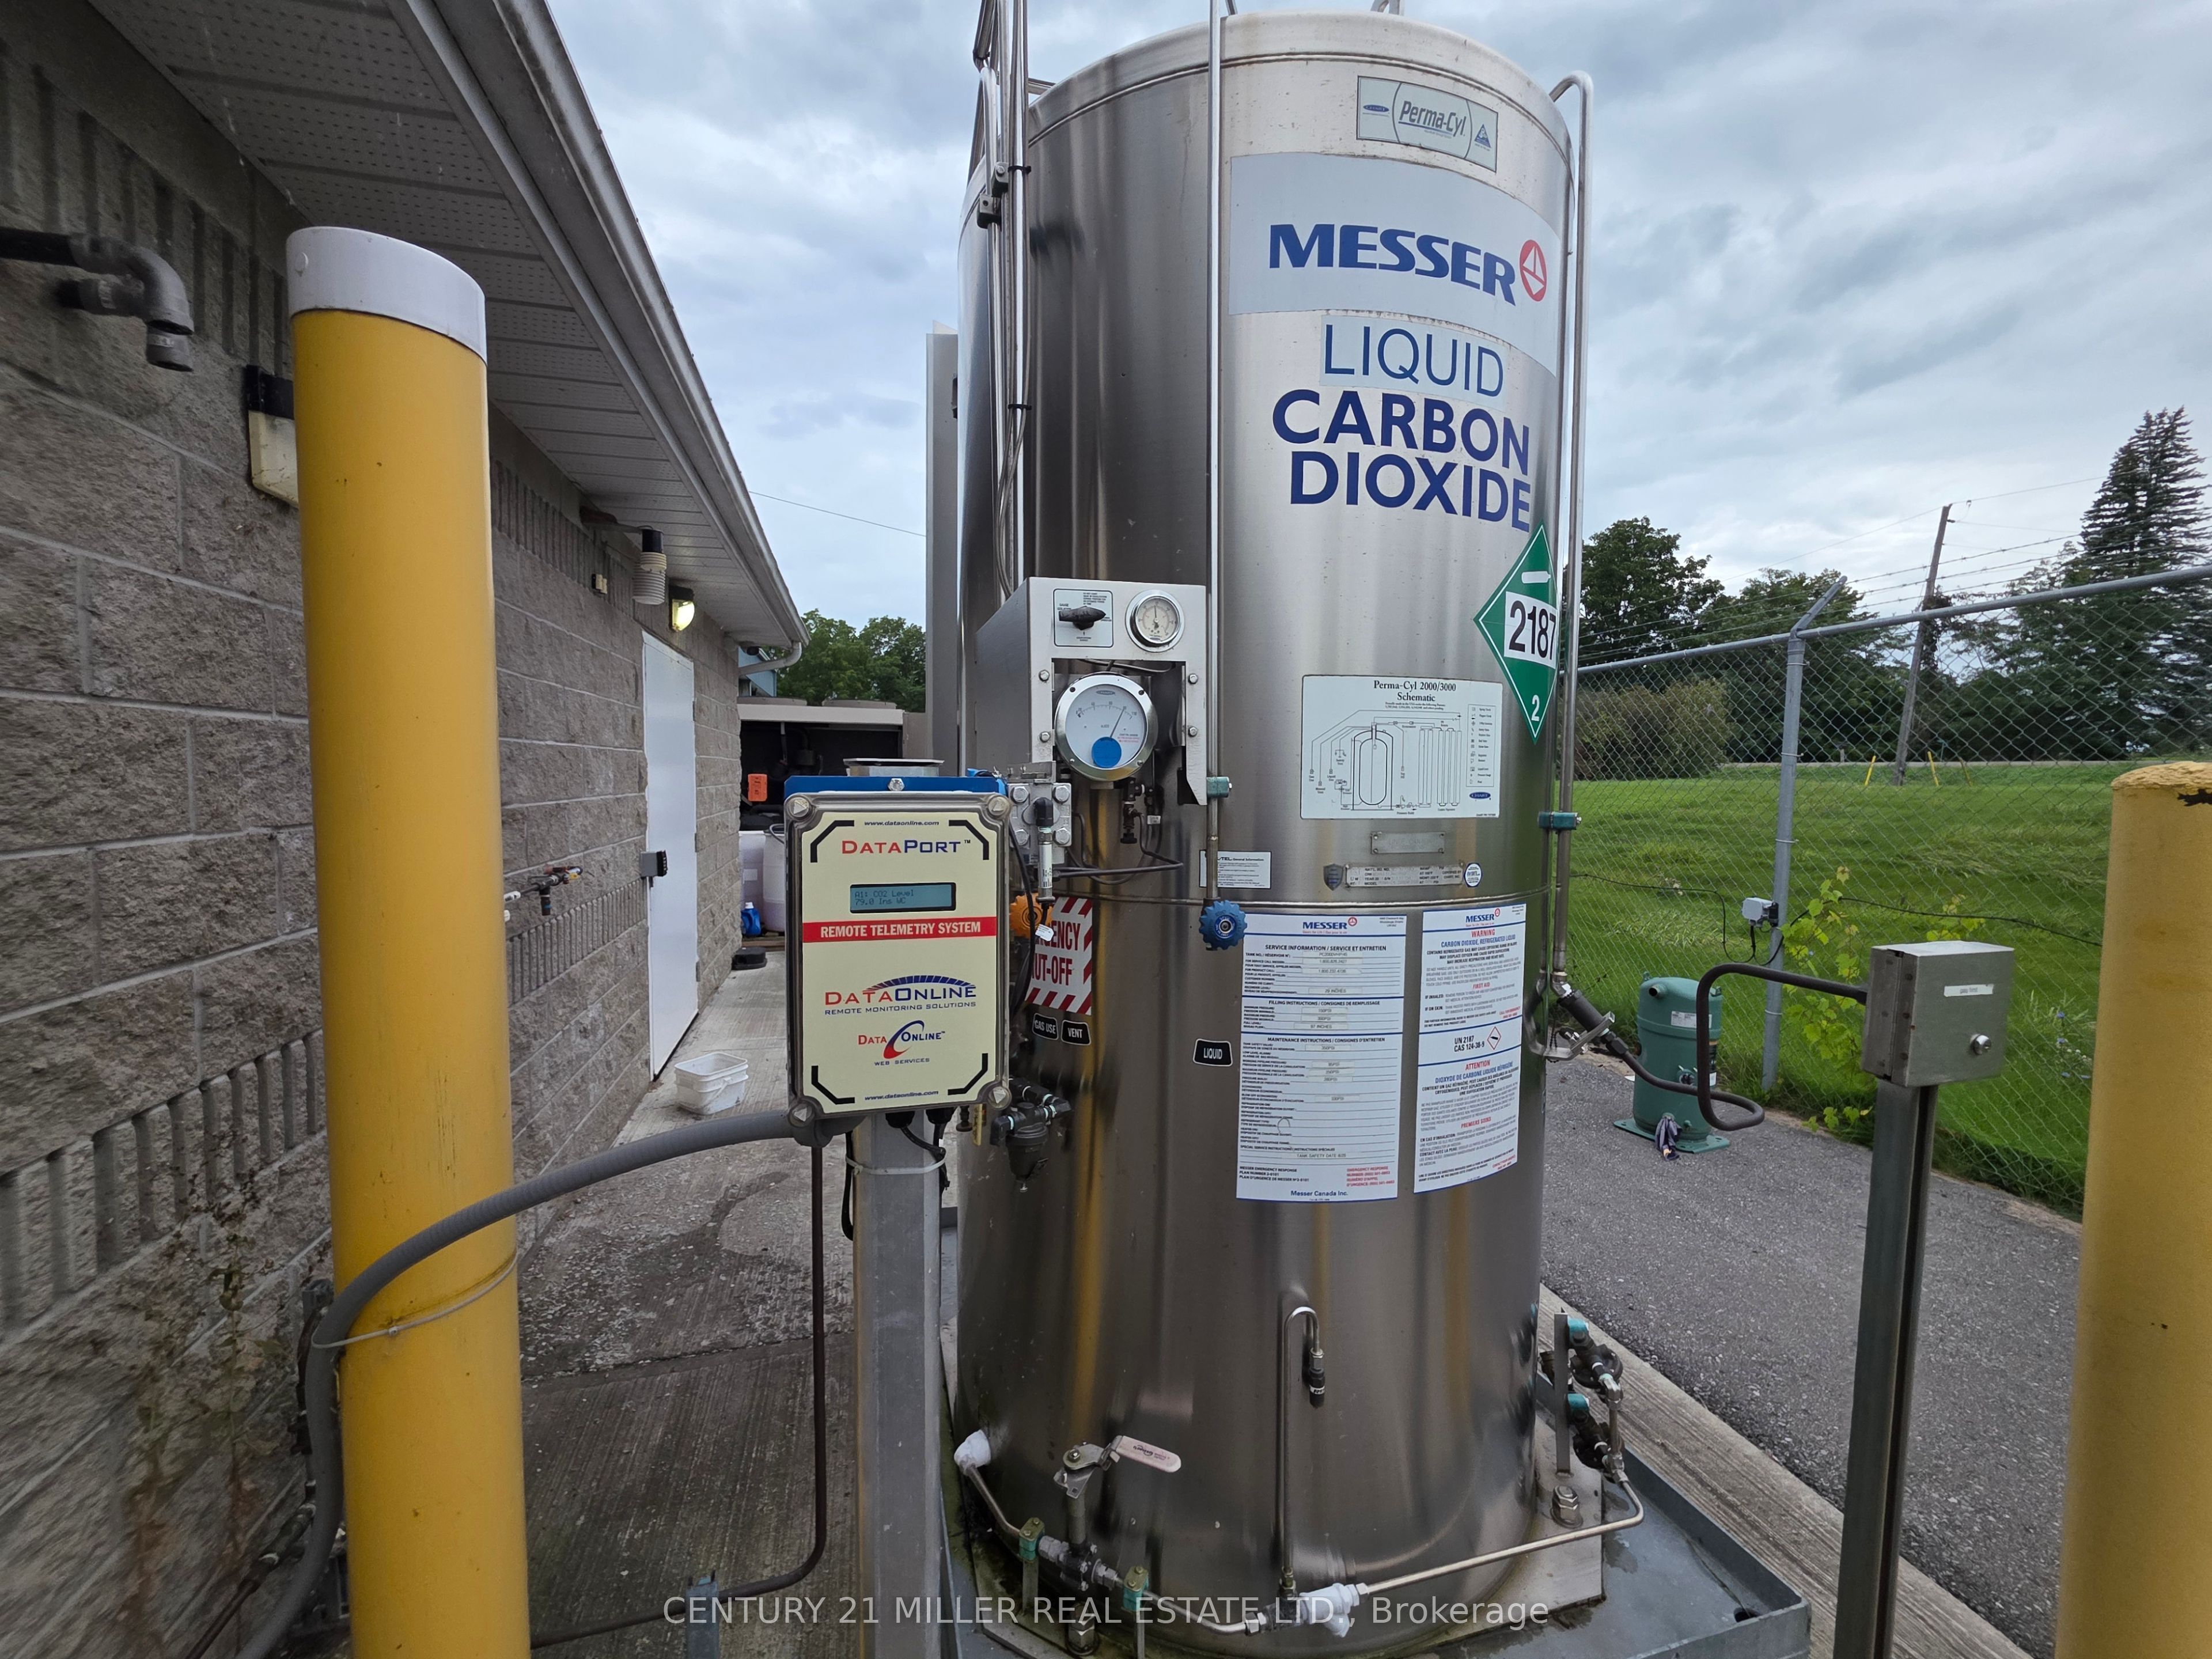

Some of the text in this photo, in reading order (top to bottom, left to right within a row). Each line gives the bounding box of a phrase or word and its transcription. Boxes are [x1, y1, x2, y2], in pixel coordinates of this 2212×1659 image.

[1269, 224, 1516, 306] MESSER
[1324, 324, 1504, 397] LIQUID
[1272, 389, 1529, 476] CARBON
[1290, 450, 1531, 532] DIOXIDE
[1508, 600, 1556, 661] 2187
[1373, 680, 1456, 692] Perma-Cyl 2000/3000
[1397, 692, 1436, 702] Schematic
[1531, 694, 1540, 721] 2
[1465, 914, 1495, 923] MESSER
[820, 921, 981, 938] REMOTE TELEMETRY SYSTEM
[1302, 921, 1347, 930] MESSER
[1471, 929, 1495, 938] WARNING
[824, 1001, 977, 1016] REMOTE MONITORING SOLUTIONS
[1034, 1020, 1056, 1034] GAS USE
[858, 1031, 942, 1046] DATA ONLINE
[1067, 1028, 1083, 1039] VENT
[1463, 1035, 1475, 1044] 2187
[1203, 1047, 1223, 1060] LIQUID
[1454, 1044, 1465, 1052] CAS
[1465, 1059, 1491, 1071] ATTENTION
[1435, 1075, 1456, 1084] DIOXYDE
[864, 1090, 939, 1100] www.dataonline.com
[1461, 1119, 1480, 1128] PREMIERS
